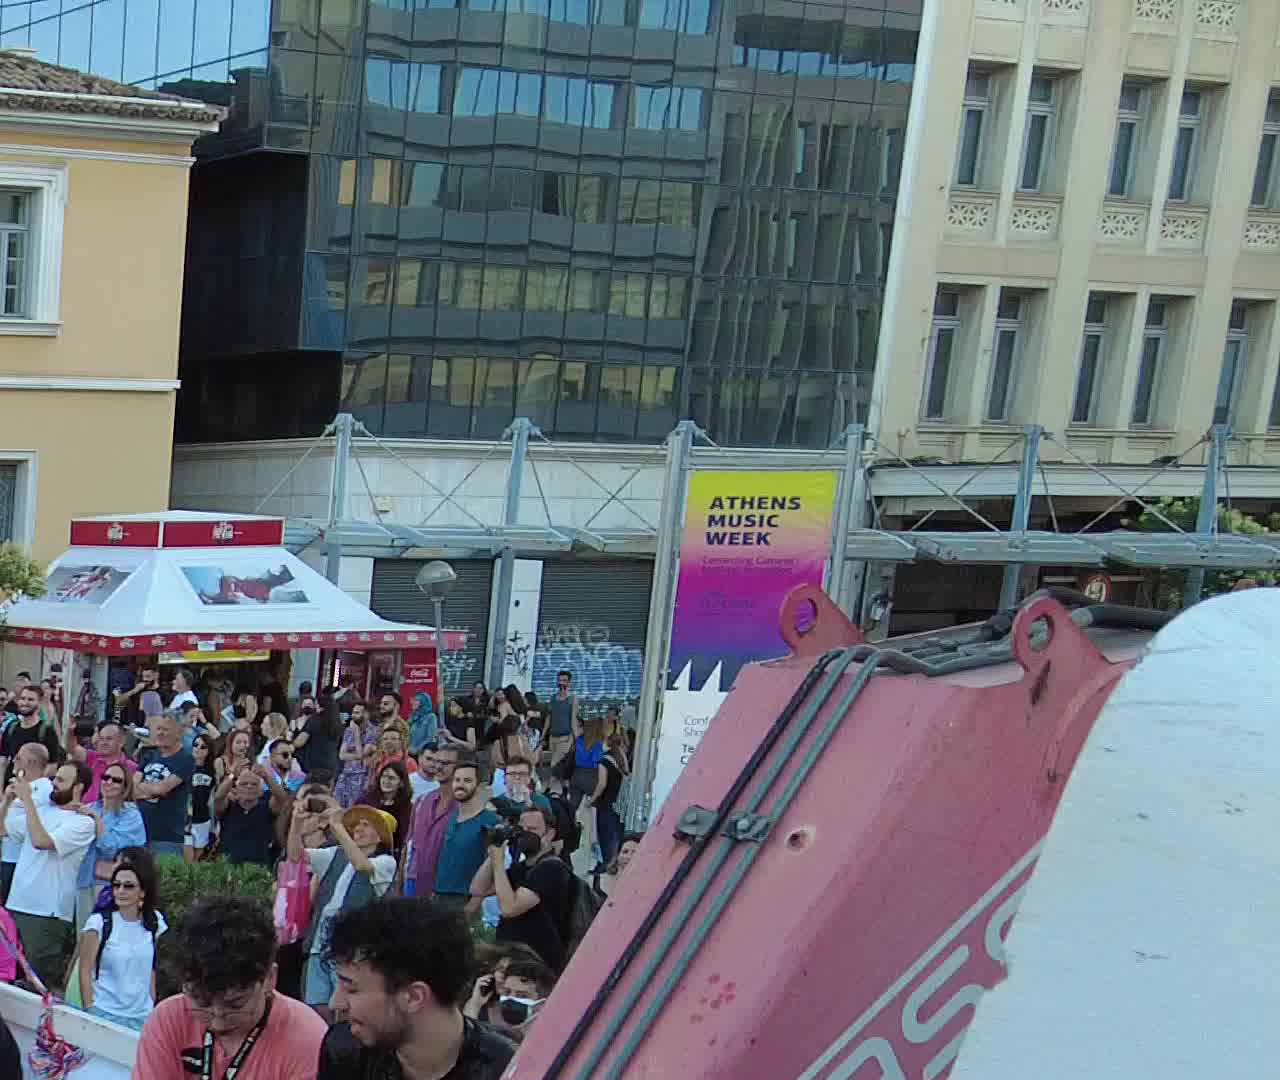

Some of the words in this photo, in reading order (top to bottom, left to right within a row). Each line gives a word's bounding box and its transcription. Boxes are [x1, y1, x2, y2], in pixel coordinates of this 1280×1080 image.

[709, 496, 801, 511] ATHENS
[707, 514, 780, 528] MUSIC
[705, 531, 772, 546] WEEK
